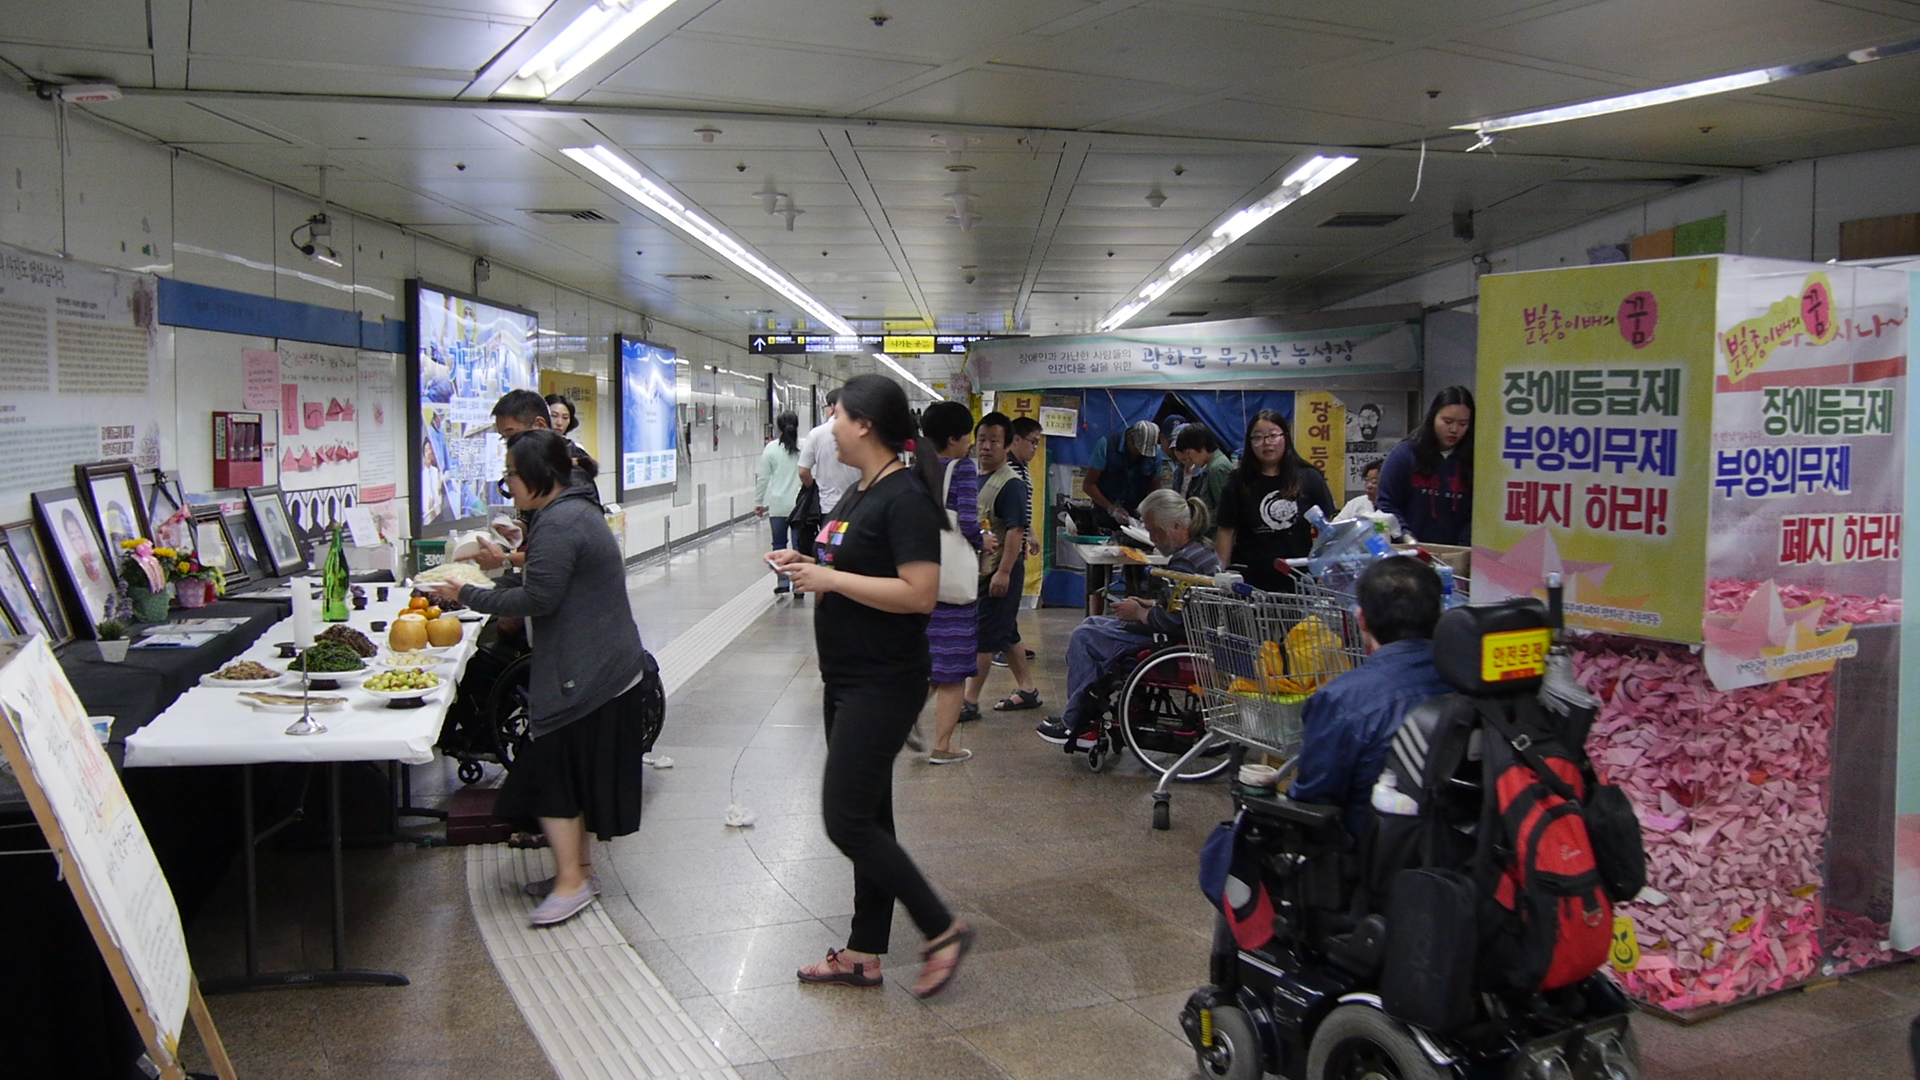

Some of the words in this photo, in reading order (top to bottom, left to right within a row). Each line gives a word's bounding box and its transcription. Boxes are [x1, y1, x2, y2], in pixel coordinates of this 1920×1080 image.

[1523, 303, 1615, 345] 분홍종이배의
[1626, 295, 1649, 345] 꿈
[1803, 288, 1825, 338] 꿈
[1018, 352, 1057, 364] 장애인과
[1061, 351, 1089, 362] 가난한
[1093, 349, 1132, 360] 사람들의
[1047, 363, 1086, 374] 인간다운
[1089, 362, 1109, 373] 삶을
[1112, 361, 1132, 372] 위한
[1141, 346, 1208, 371] 광화문
[1218, 344, 1281, 367] 무기한
[1290, 339, 1355, 366] 농성장
[1502, 368, 1680, 418] 장애등급제
[1762, 387, 1893, 437] 장애등급제
[1502, 426, 1677, 477] 부양의무제
[1715, 445, 1852, 498] 부양의무제
[1505, 481, 1571, 529] 폐지
[1585, 484, 1668, 536] 하라!
[1780, 516, 1834, 563] 폐지
[1843, 514, 1901, 561] 하라!
